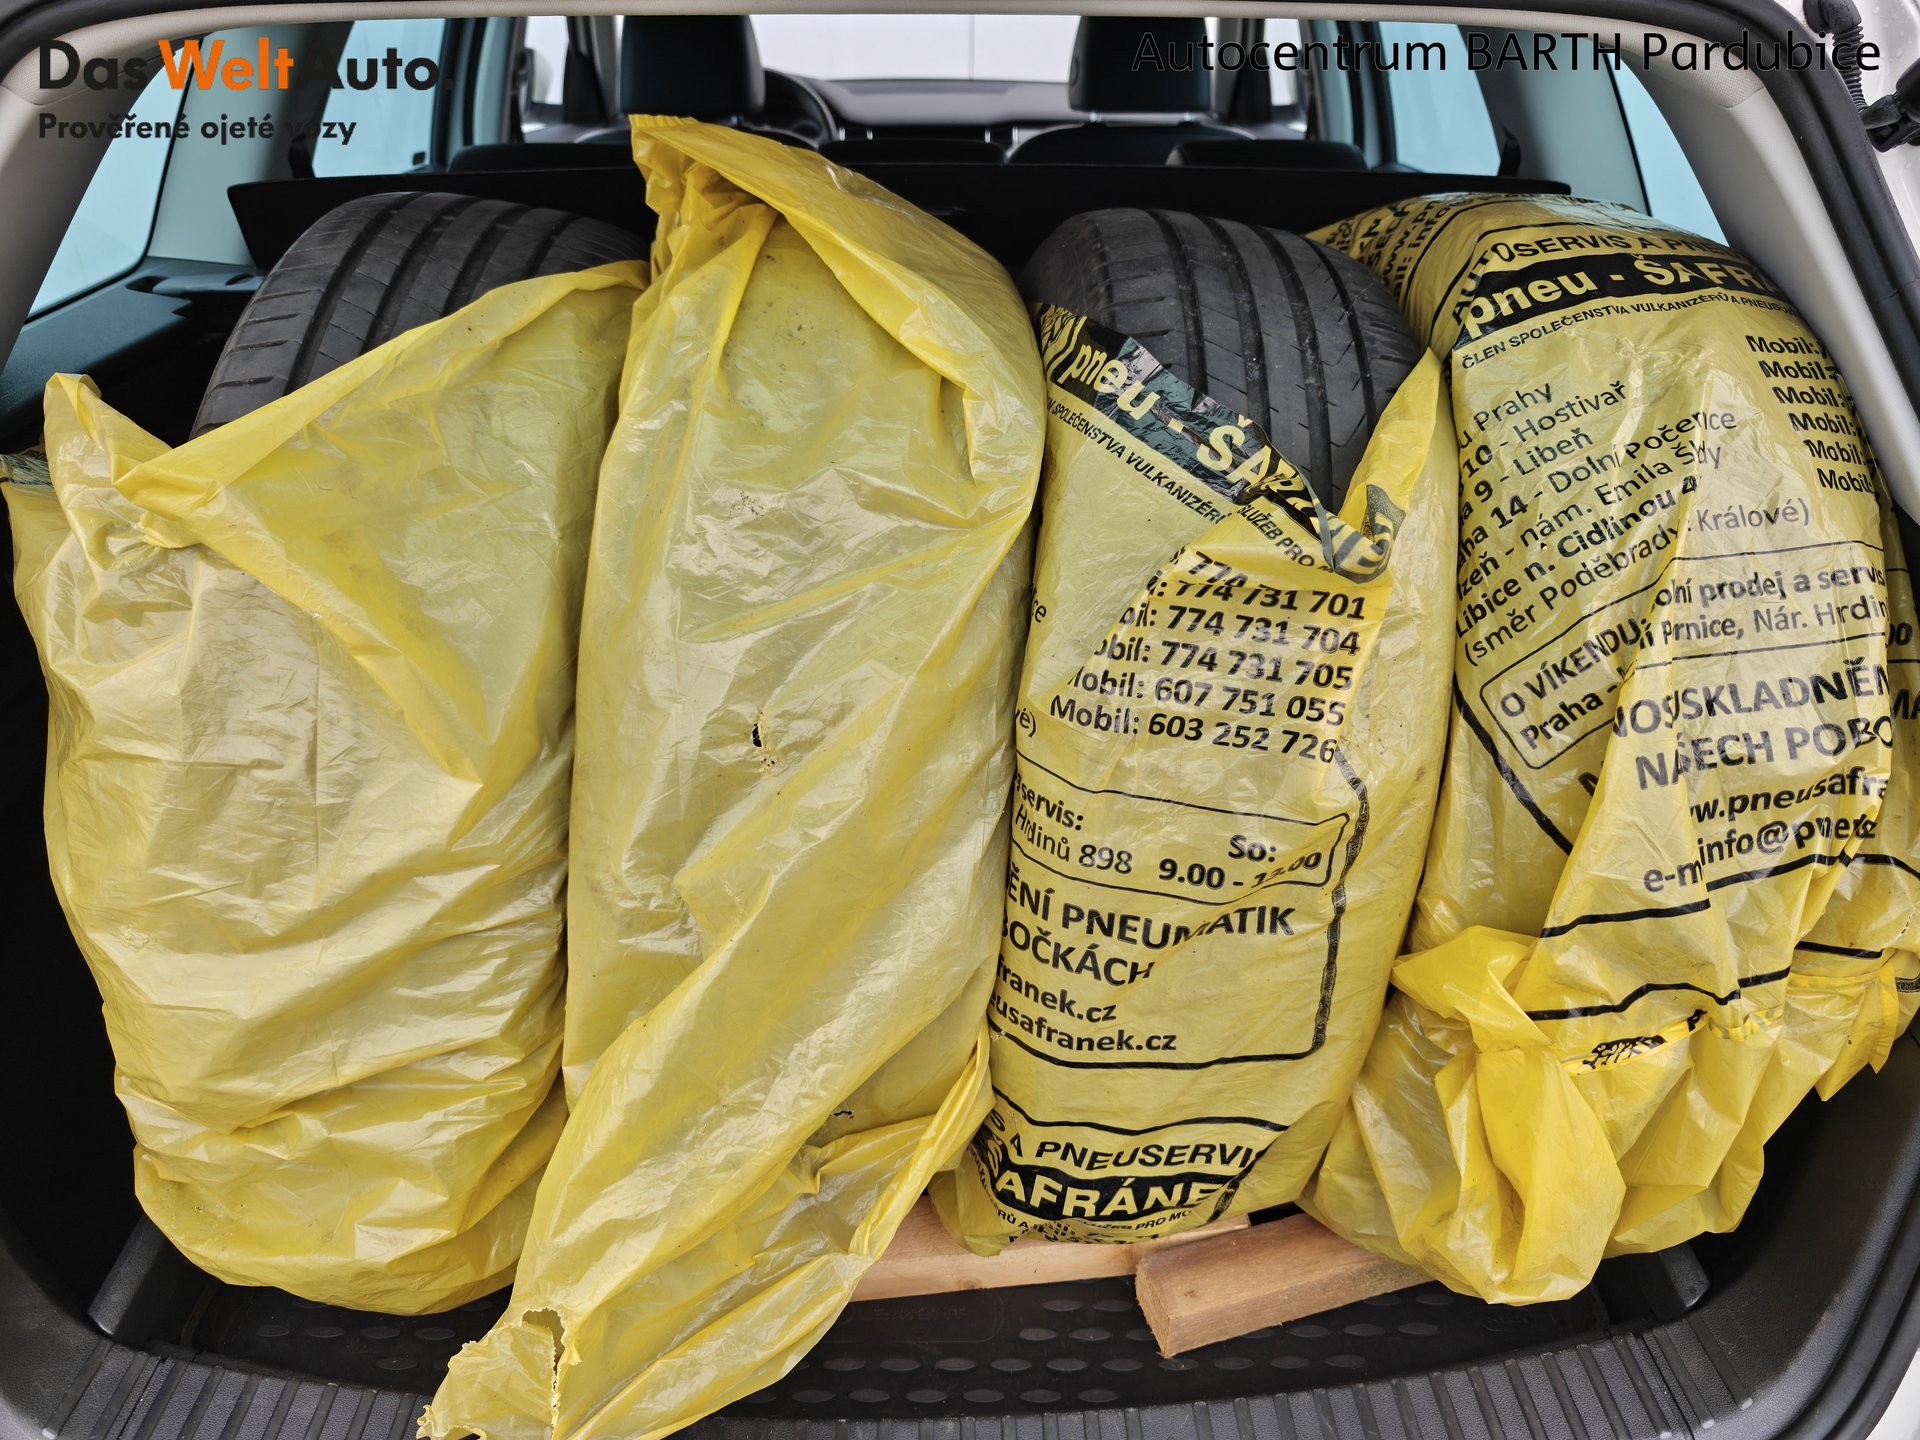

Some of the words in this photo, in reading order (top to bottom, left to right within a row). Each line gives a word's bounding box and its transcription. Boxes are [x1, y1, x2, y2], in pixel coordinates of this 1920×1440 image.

[1451, 235, 1632, 326] AUTOSERVIS
[1637, 236, 1658, 250] A
[1463, 271, 1598, 340] pneu
[1462, 341, 1507, 370] ČLEN
[1508, 304, 1630, 348] SPOLEČENSTVA
[1630, 292, 1730, 312] VULKANIZÉRŮ
[1745, 335, 1820, 355] Mobil:
[1057, 344, 1162, 421] pneu
[1473, 383, 1553, 432] Prahy
[1771, 386, 1846, 408] Mobil:
[1052, 401, 1127, 459] SPOLEČENSTVA
[1462, 444, 1493, 479] 10
[1512, 380, 1627, 443] Hostivař
[1788, 412, 1857, 437] Mobil:
[1473, 480, 1494, 503] 9
[1512, 427, 1594, 476] Libeň
[1803, 439, 1868, 465] Mobil:
[1490, 494, 1529, 529] 14
[1519, 503, 1593, 548] nám.
[1594, 461, 1674, 506] Emila
[1696, 497, 1810, 533] Králové)
[1274, 537, 1316, 567] PRO
[1456, 578, 1522, 638] Libice
[1523, 560, 1556, 582] n.
[1557, 489, 1677, 558] Cidlinou
[1167, 605, 1225, 636] 774
[1233, 614, 1290, 645] 731
[1301, 623, 1361, 656] 704
[1308, 590, 1366, 621] 701
[1464, 603, 1536, 668] (směr
[1500, 691, 1526, 718] O
[1699, 571, 1787, 609] prodej
[1793, 572, 1811, 593] a
[1161, 640, 1218, 672] 774
[1227, 650, 1283, 683] 731
[1295, 659, 1354, 691] 705
[1519, 690, 1605, 750] Praha
[1753, 605, 1808, 633] Nár.
[1154, 677, 1214, 707] 607
[1221, 685, 1276, 717] 751
[1285, 695, 1347, 726] 055
[1050, 694, 1140, 735] Mobil:
[1148, 713, 1205, 741] 603
[1212, 721, 1270, 751] 252
[1281, 729, 1338, 764] 726
[1015, 804, 1071, 862] Hrdinů
[1078, 844, 1133, 875] 898
[1158, 857, 1226, 891] 9.00
[1021, 783, 1084, 831] servis:
[1228, 834, 1277, 863] So:
[1061, 902, 1296, 950] PNEUMATIK
[1009, 1132, 1024, 1158] A
[1134, 1217, 1167, 1231] PRO
